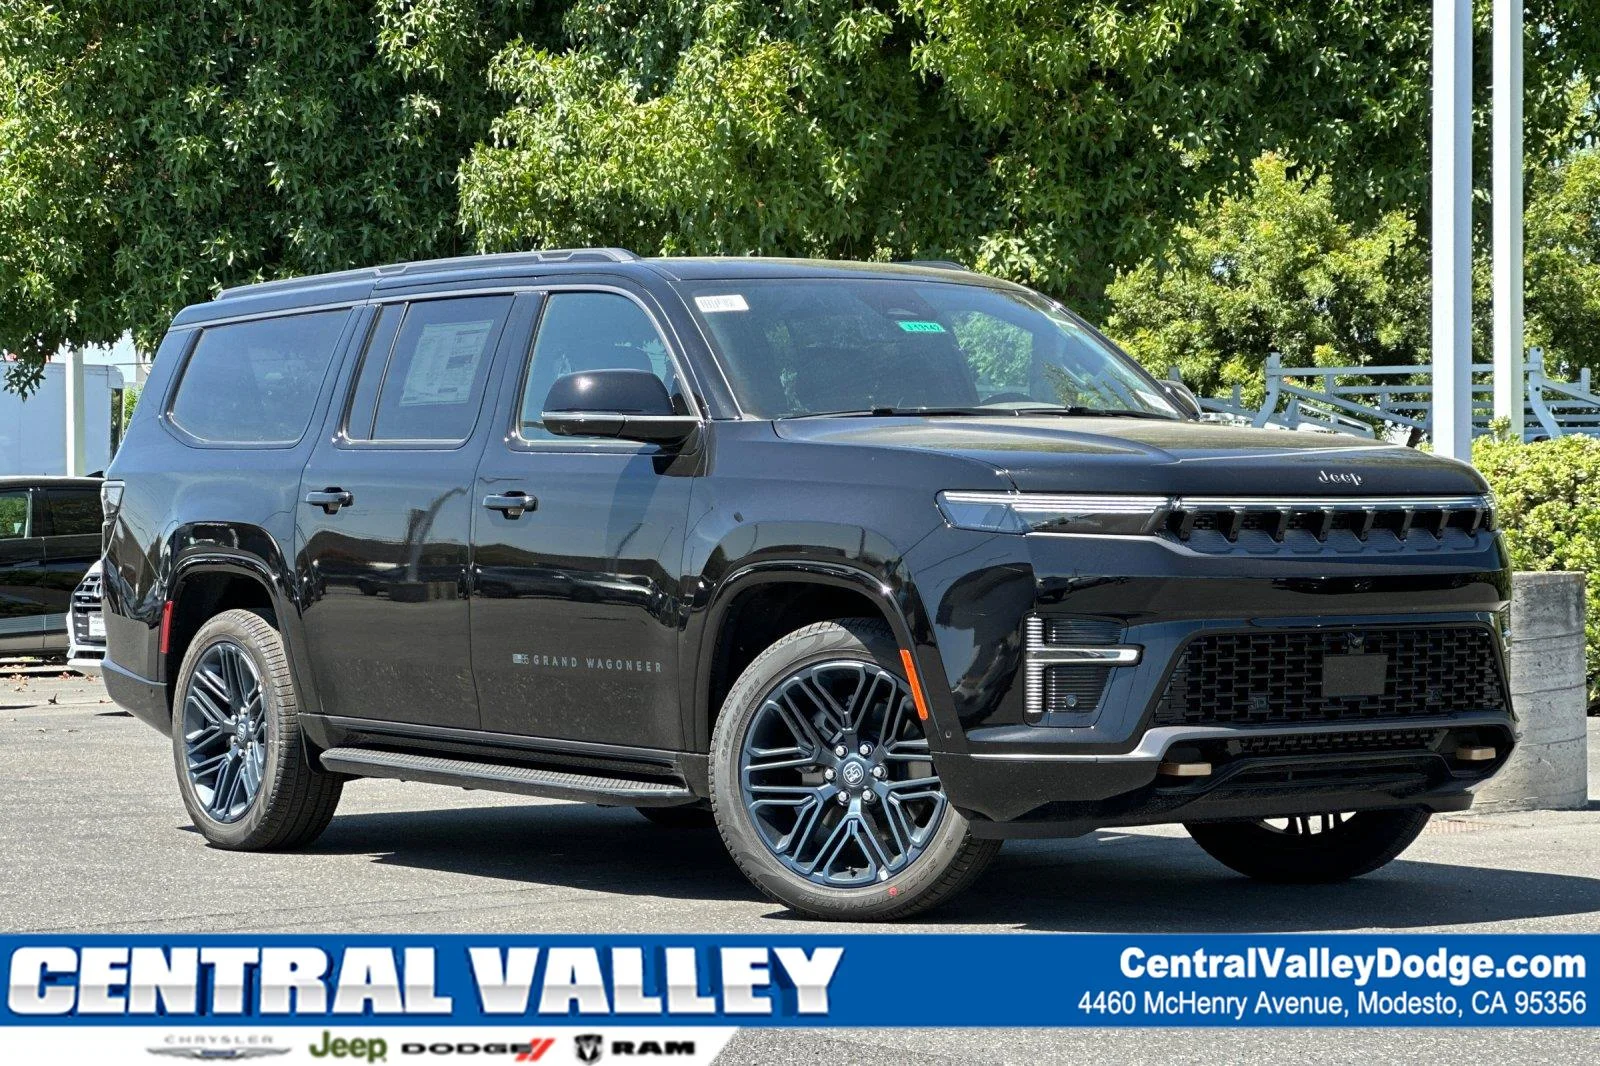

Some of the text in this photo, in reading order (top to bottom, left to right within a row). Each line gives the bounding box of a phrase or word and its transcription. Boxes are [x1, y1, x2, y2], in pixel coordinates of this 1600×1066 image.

[1318, 470, 1363, 486] Jeep
[533, 654, 662, 673] GRAND WAGONEER
